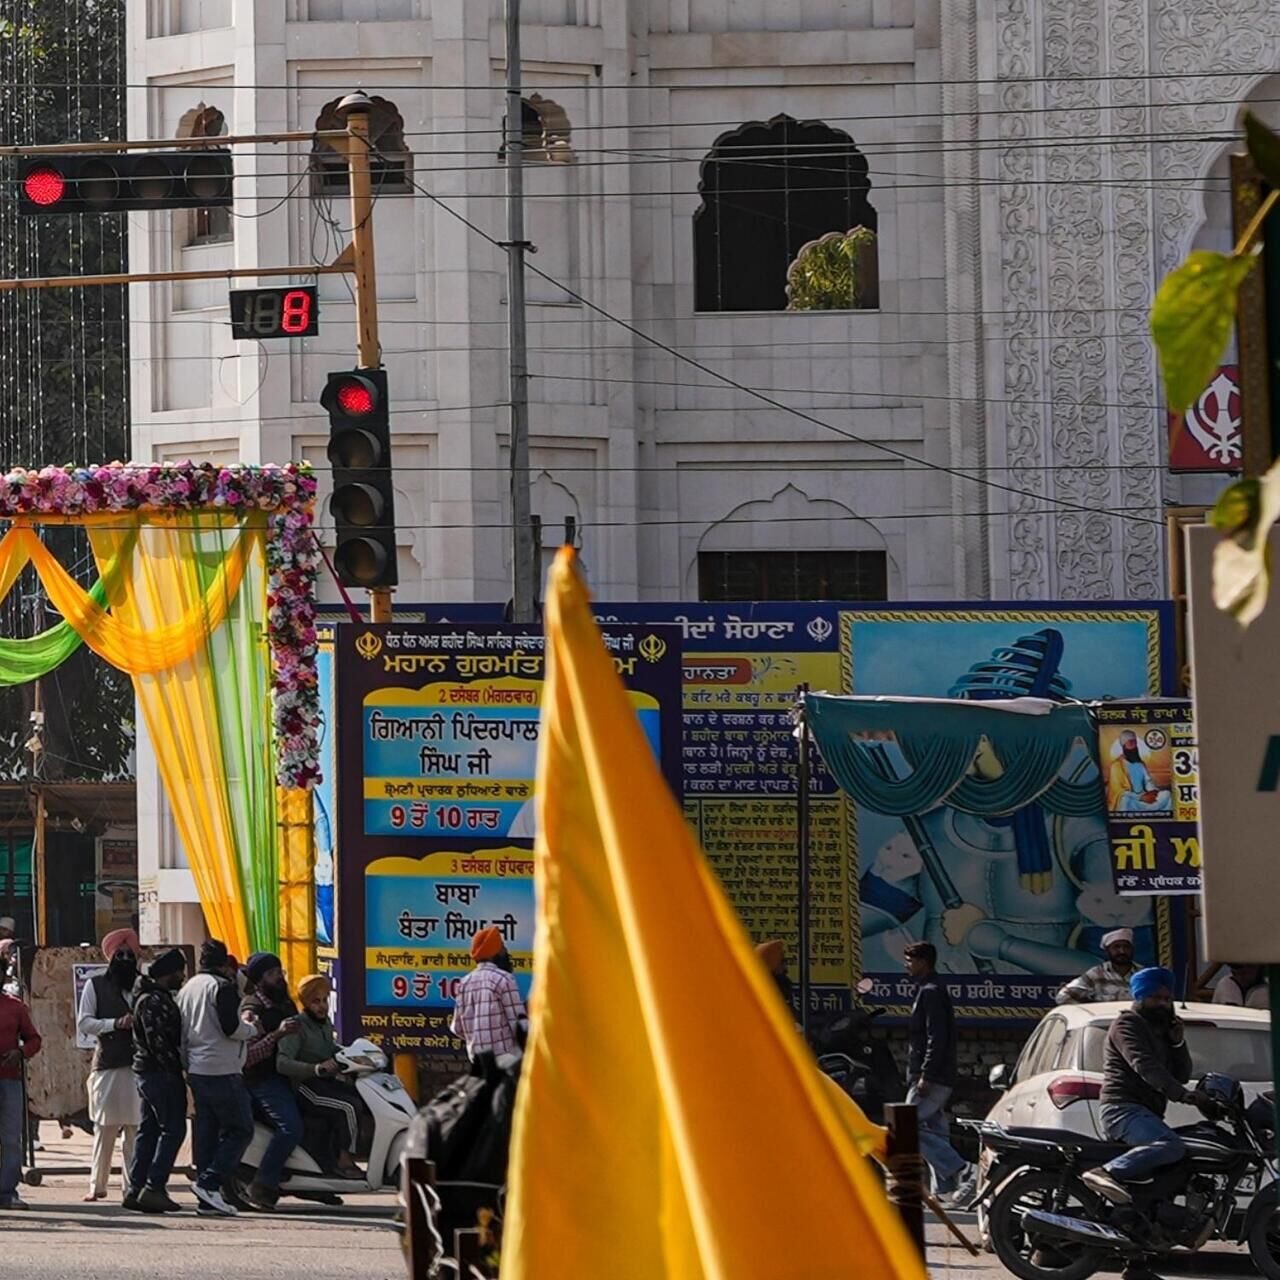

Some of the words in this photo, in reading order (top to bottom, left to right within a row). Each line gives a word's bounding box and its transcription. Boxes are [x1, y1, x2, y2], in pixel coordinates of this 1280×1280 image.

[724, 615, 794, 640] ਸੋਹਾਣਾ
[383, 655, 450, 672] ਮਹਾਨ
[455, 650, 543, 676] ਗੁਰਮਤਿ
[682, 666, 737, 679] ਹਾਨਤਾ
[371, 711, 445, 740] ਗਿਆਨੀ
[420, 747, 461, 775] ਸਿੰਘ
[467, 749, 491, 774] ਜੀ
[391, 806, 405, 827] 9
[410, 803, 428, 827] ਤੋਂ
[436, 807, 461, 828] 10
[467, 810, 500, 828] ਰਾਤ
[1112, 825, 1156, 869] ਜੀ
[435, 883, 480, 905] ਬਾਬਾ
[399, 911, 439, 939] ਬੰਤਾ
[394, 976, 407, 998] 9
